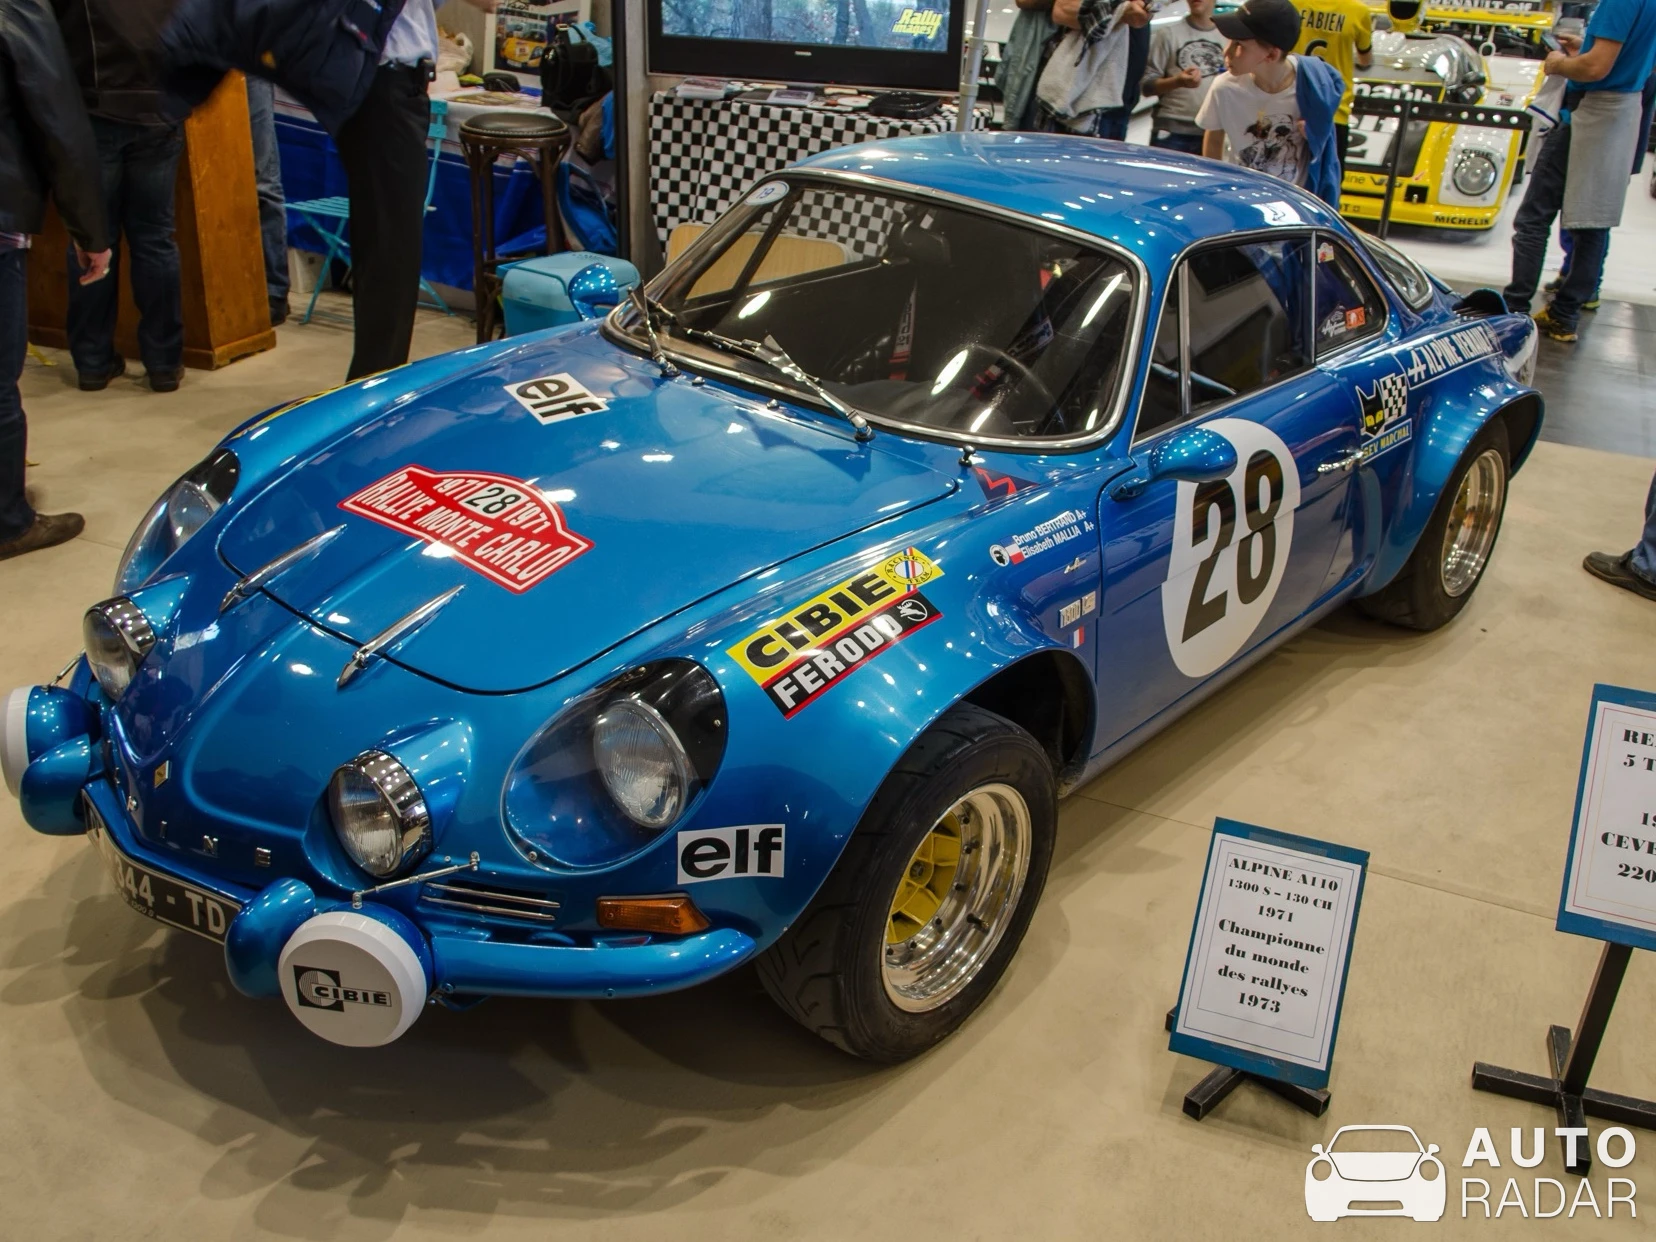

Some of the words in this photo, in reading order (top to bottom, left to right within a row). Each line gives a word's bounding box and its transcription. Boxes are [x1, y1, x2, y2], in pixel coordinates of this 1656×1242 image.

[899, 8, 943, 39] Rally
[1301, 9, 1346, 32] FABIEN
[1353, 83, 1432, 103] nault
[1434, 214, 1490, 227] MICHELIN
[1421, 336, 1464, 375] ALPINE
[1450, 325, 1494, 361] RENAULT
[516, 378, 604, 418] elf
[1380, 425, 1410, 450] MARCHAL
[433, 478, 488, 500] 1971
[465, 486, 522, 514] 28
[502, 501, 552, 534] 1971
[356, 472, 437, 521] RALLYE
[413, 506, 494, 548] MONTE
[474, 532, 572, 581] CARLO
[1012, 530, 1037, 546] Bruno
[1035, 510, 1077, 536] BERTRAND
[1075, 509, 1087, 520] A+
[1020, 536, 1055, 558] Elisabeth
[1054, 526, 1082, 545] MALLIA
[1084, 521, 1095, 533] A+
[1181, 449, 1284, 643] 28
[887, 554, 918, 573] RACING
[907, 571, 930, 584] TEAM
[772, 613, 903, 709] FERODO
[1622, 728, 1656, 748] RE
[1623, 754, 1636, 767] 5
[681, 827, 783, 878] elf
[1228, 858, 1293, 881] ALPINE
[1297, 873, 1339, 891] A110
[1228, 878, 1259, 893] 1300
[1262, 886, 1272, 896] S
[1286, 892, 1309, 905] 130
[1313, 898, 1333, 910] CH
[184, 889, 226, 935] TD
[1258, 905, 1294, 922] 1971
[1218, 919, 1325, 955] Championne
[1225, 944, 1247, 958] du
[1252, 953, 1310, 974] monde
[1217, 965, 1246, 981] des
[1251, 976, 1309, 997] rallyes
[1239, 992, 1281, 1013] 1973
